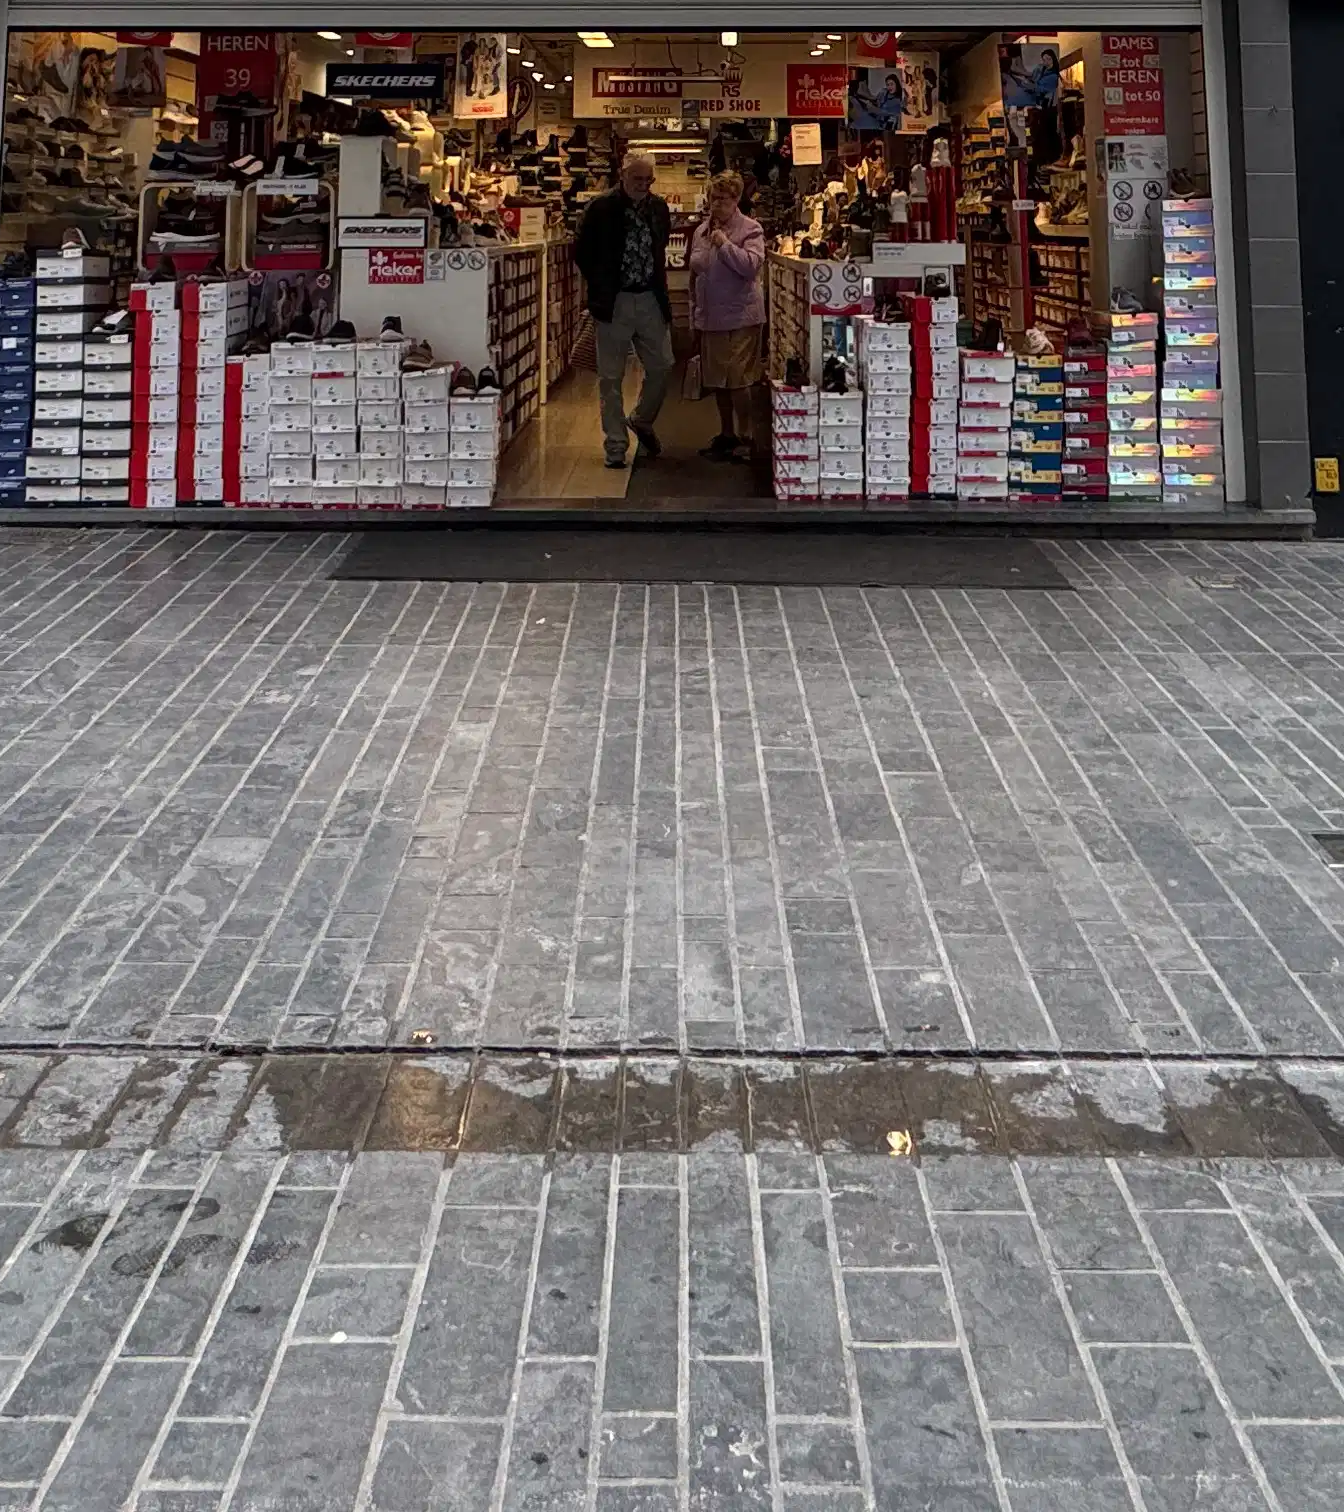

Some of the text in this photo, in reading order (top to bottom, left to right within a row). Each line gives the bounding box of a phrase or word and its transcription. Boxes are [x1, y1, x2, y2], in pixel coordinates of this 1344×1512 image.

[207, 35, 269, 52] HEREN
[1109, 37, 1154, 50] DAMES
[1122, 56, 1141, 68] tot
[224, 69, 251, 87] 39
[333, 75, 437, 87] SKECHERS
[1106, 70, 1160, 83] HEREN
[796, 85, 846, 101] rieke
[1125, 91, 1144, 101] tot
[1145, 90, 1161, 101] 50
[603, 104, 672, 115] True Denim
[700, 99, 761, 111] RED SHOE
[343, 226, 423, 234] SKECHERS
[665, 254, 686, 268] RS
[369, 262, 422, 276] rieker
